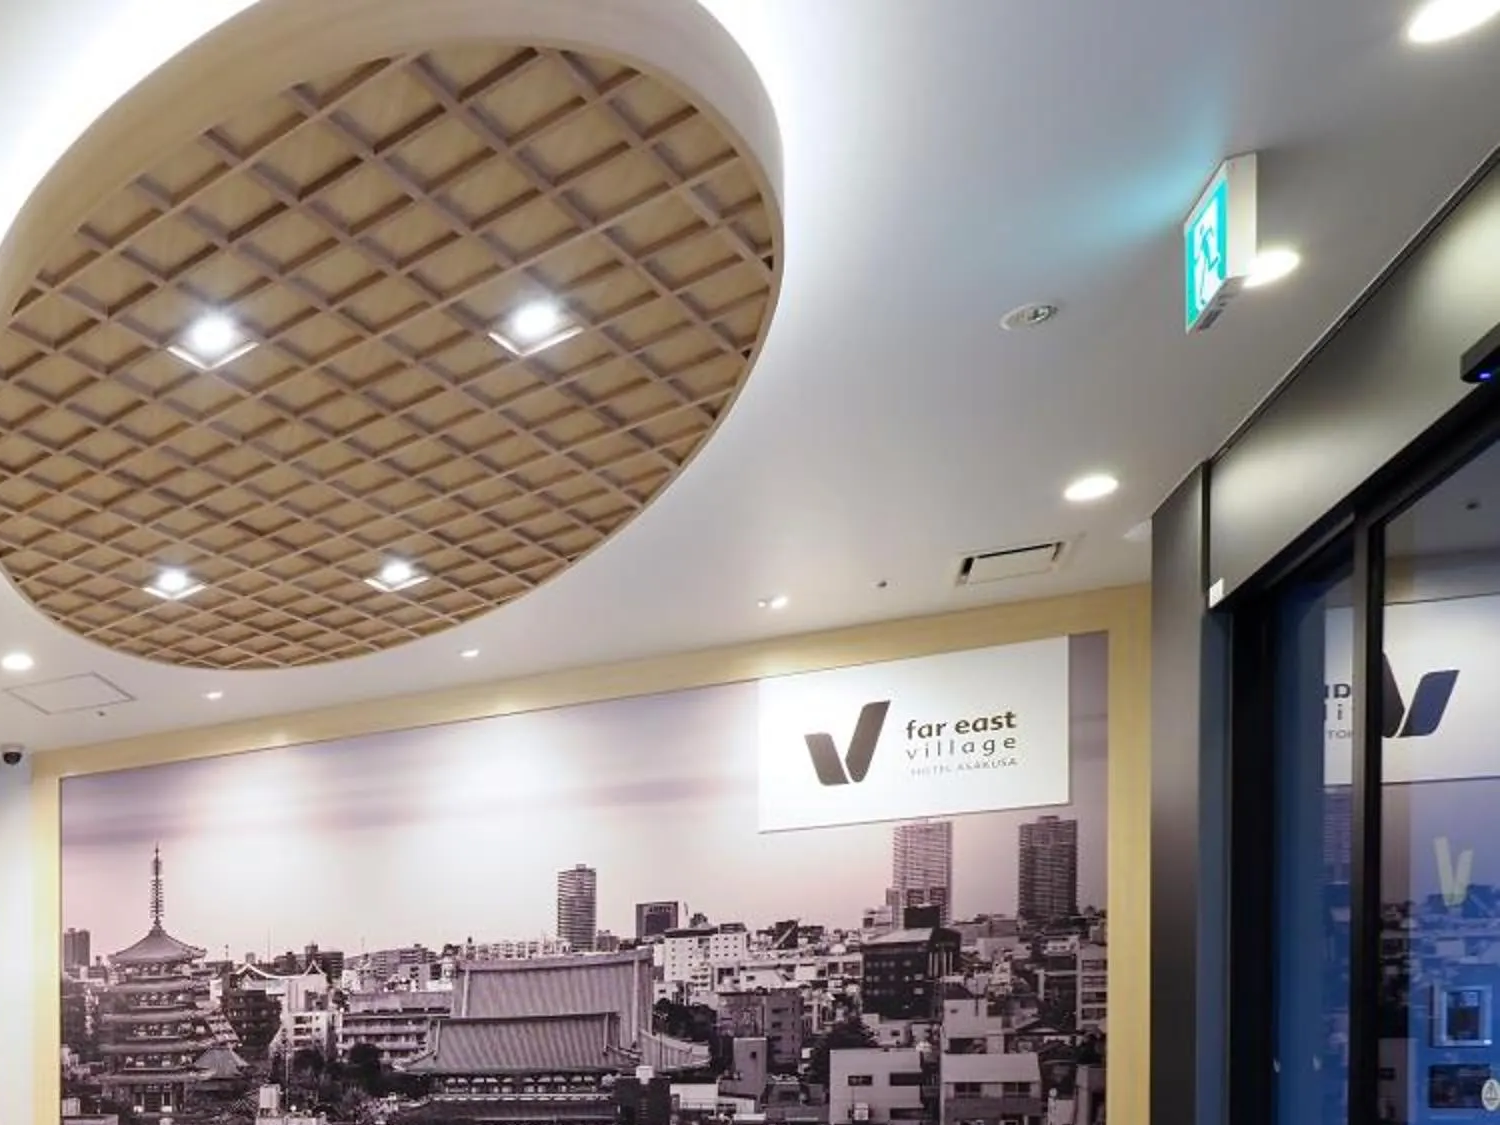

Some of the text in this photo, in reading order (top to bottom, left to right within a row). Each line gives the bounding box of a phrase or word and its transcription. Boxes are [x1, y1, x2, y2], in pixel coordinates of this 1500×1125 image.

[906, 711, 1017, 740] far east
[906, 737, 1017, 760] village
[956, 757, 1018, 771] ASAKUSA
